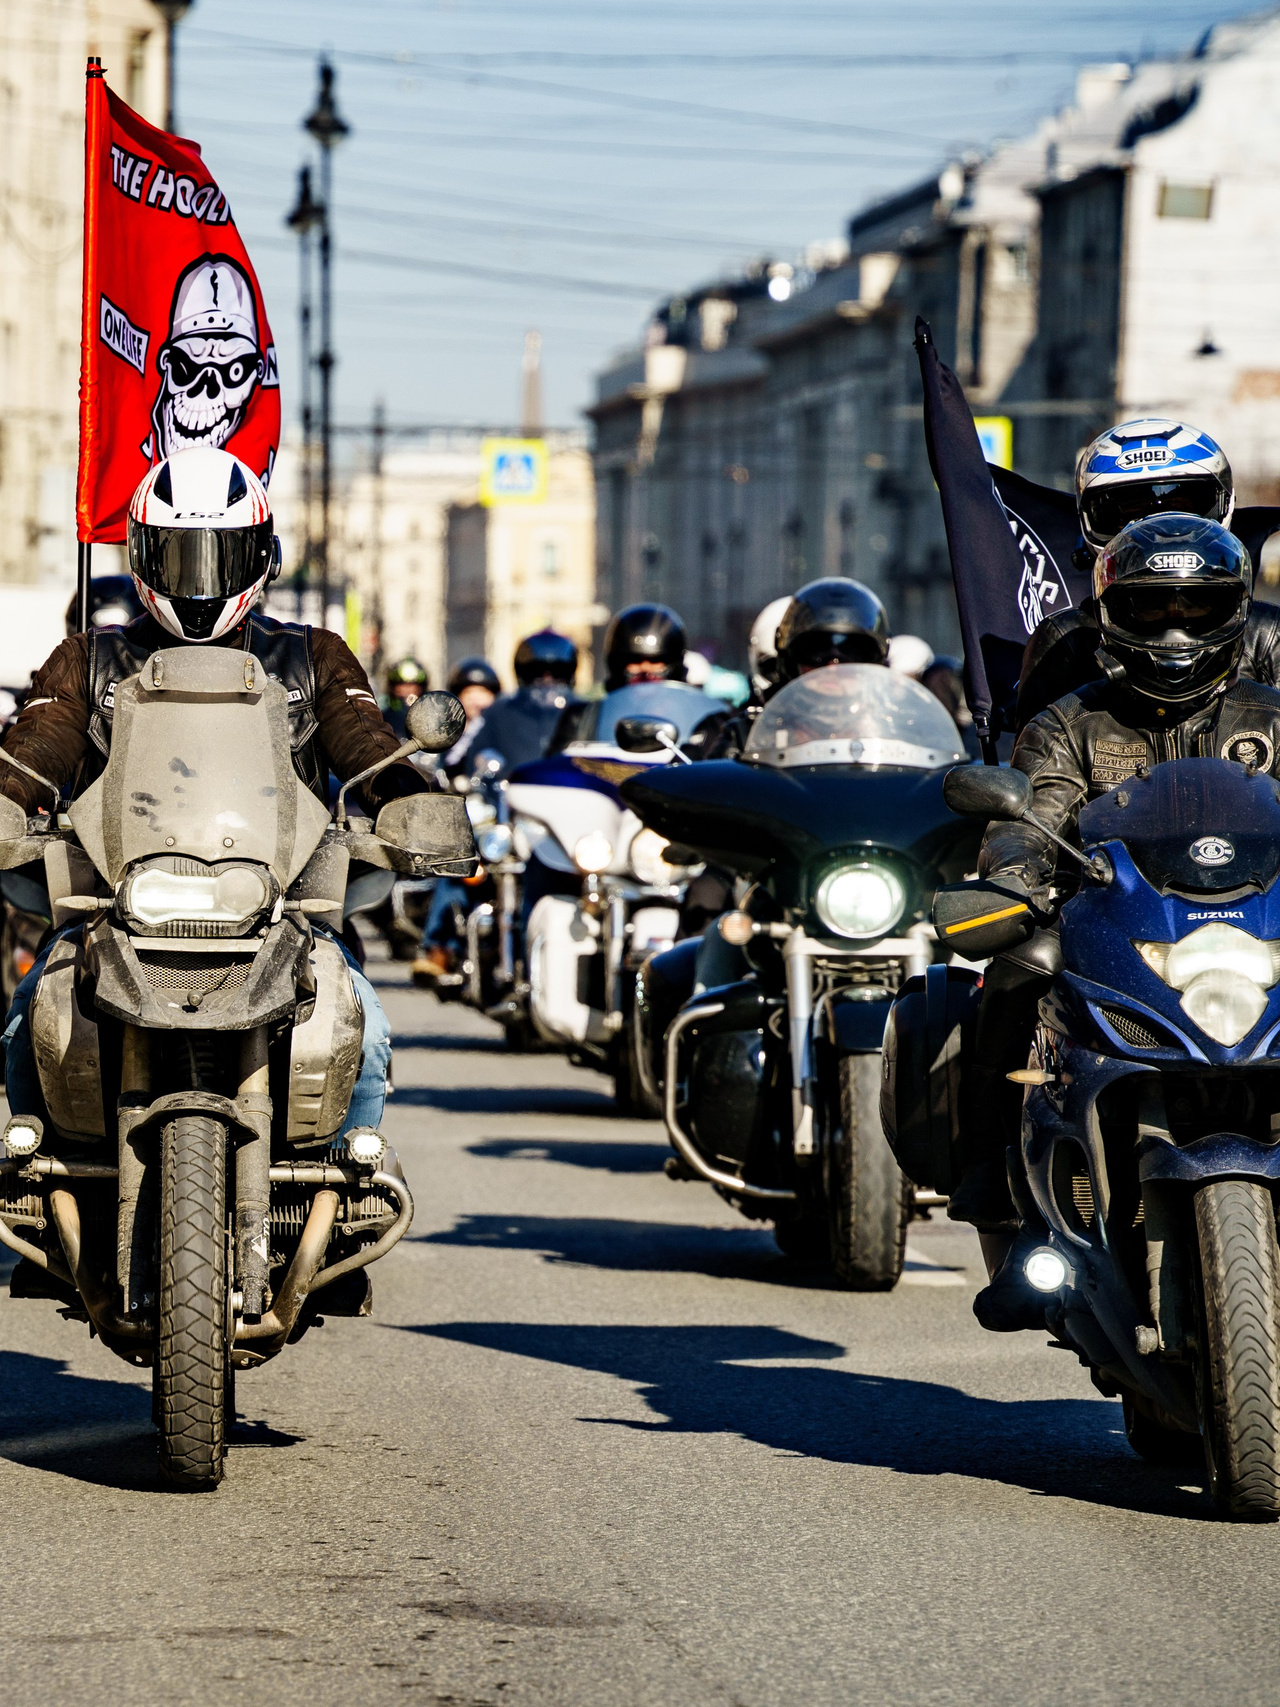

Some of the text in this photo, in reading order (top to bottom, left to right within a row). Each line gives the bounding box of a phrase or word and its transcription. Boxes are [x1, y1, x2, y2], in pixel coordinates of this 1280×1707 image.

[110, 145, 150, 200] THE
[104, 307, 143, 370] ONELIFE
[1124, 450, 1167, 466] SHOEI
[174, 512, 225, 520] LS2
[1153, 552, 1197, 569] SHOEI
[1094, 770, 1114, 780] ROAD
[1187, 911, 1245, 920] SUZUKI
